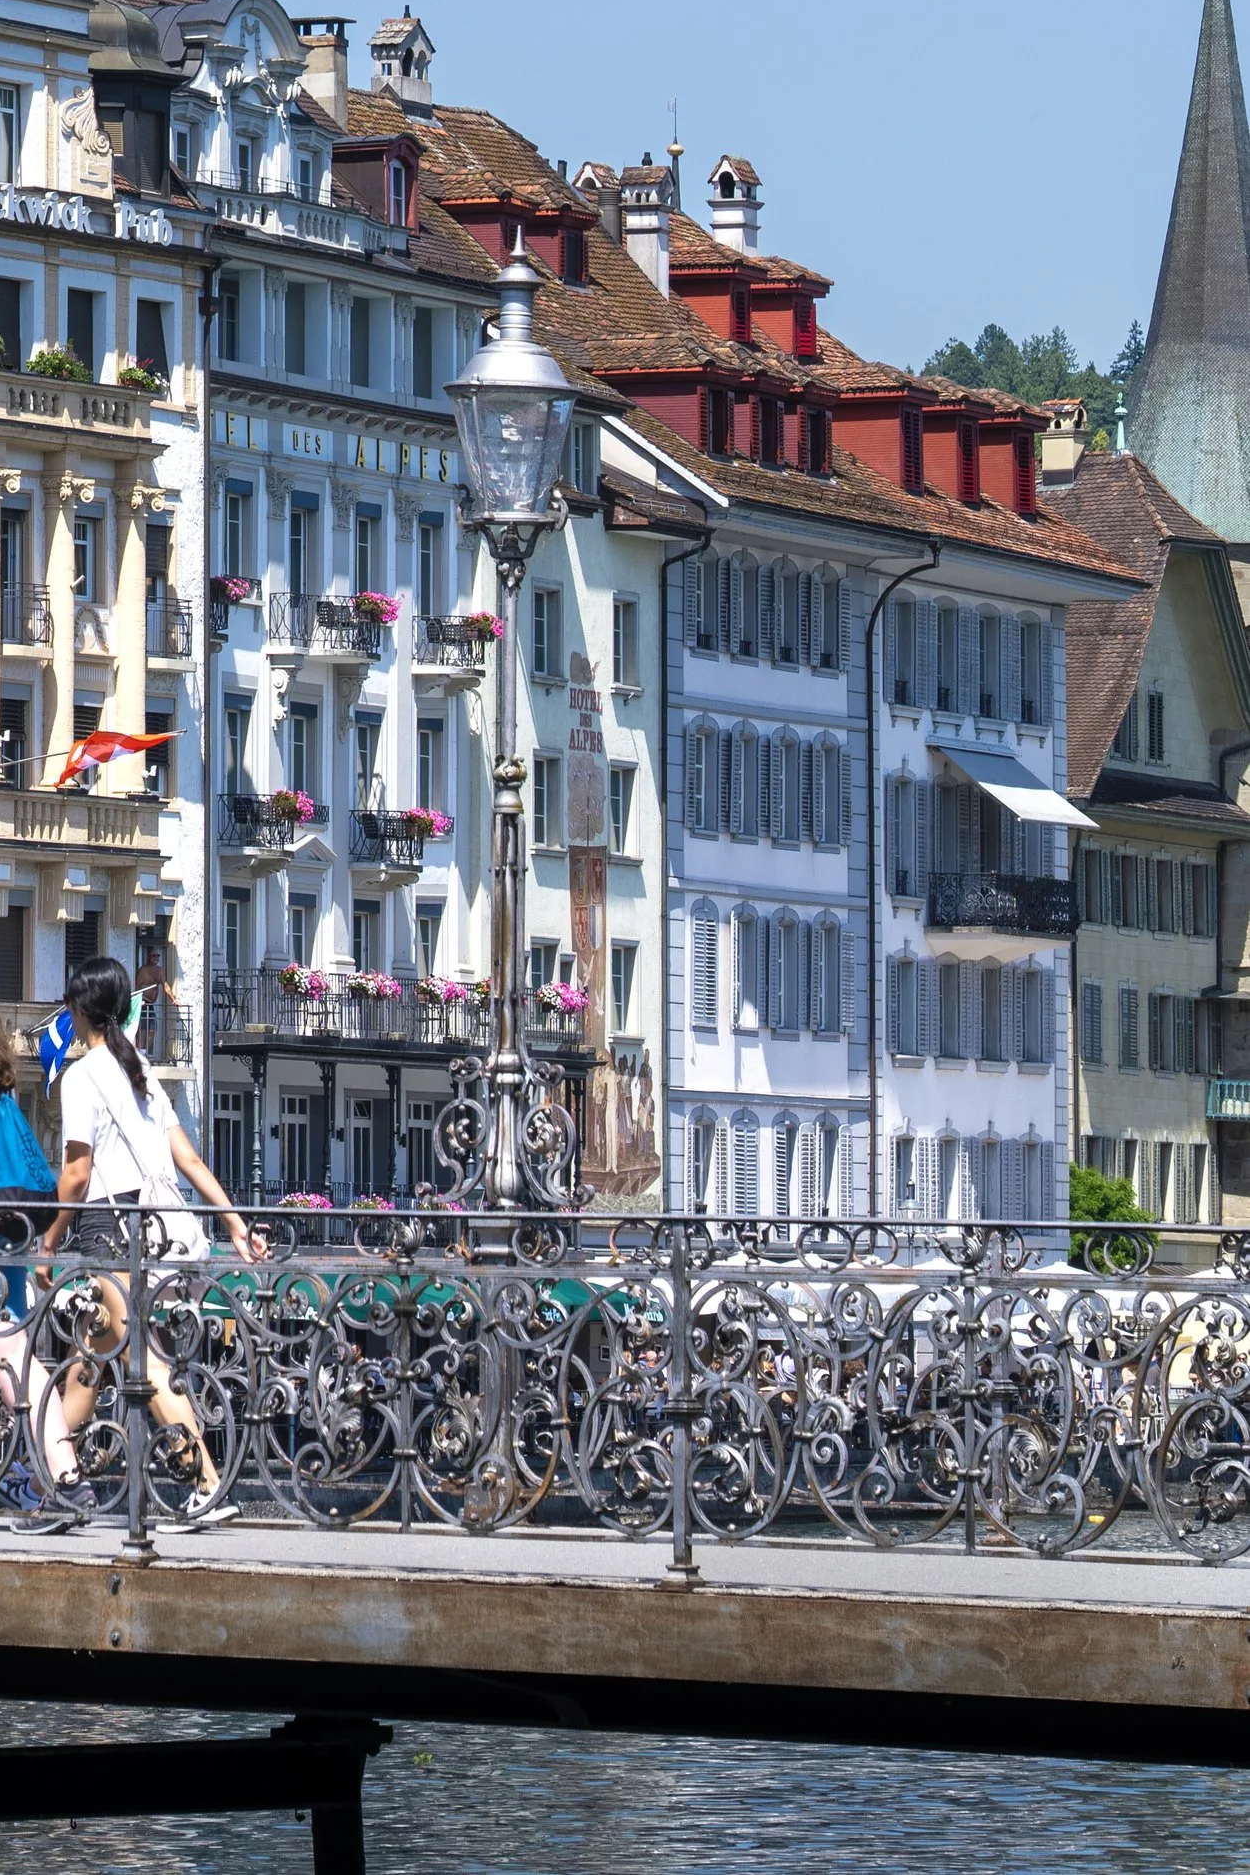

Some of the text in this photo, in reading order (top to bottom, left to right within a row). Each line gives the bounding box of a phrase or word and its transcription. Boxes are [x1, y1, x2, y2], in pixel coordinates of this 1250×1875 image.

[115, 202, 173, 246] Pub
[293, 430, 321, 455] DES
[356, 436, 448, 482] ALPES
[570, 688, 603, 713] HOTEL
[580, 713, 592, 728] DES
[569, 728, 603, 753] ALPES
